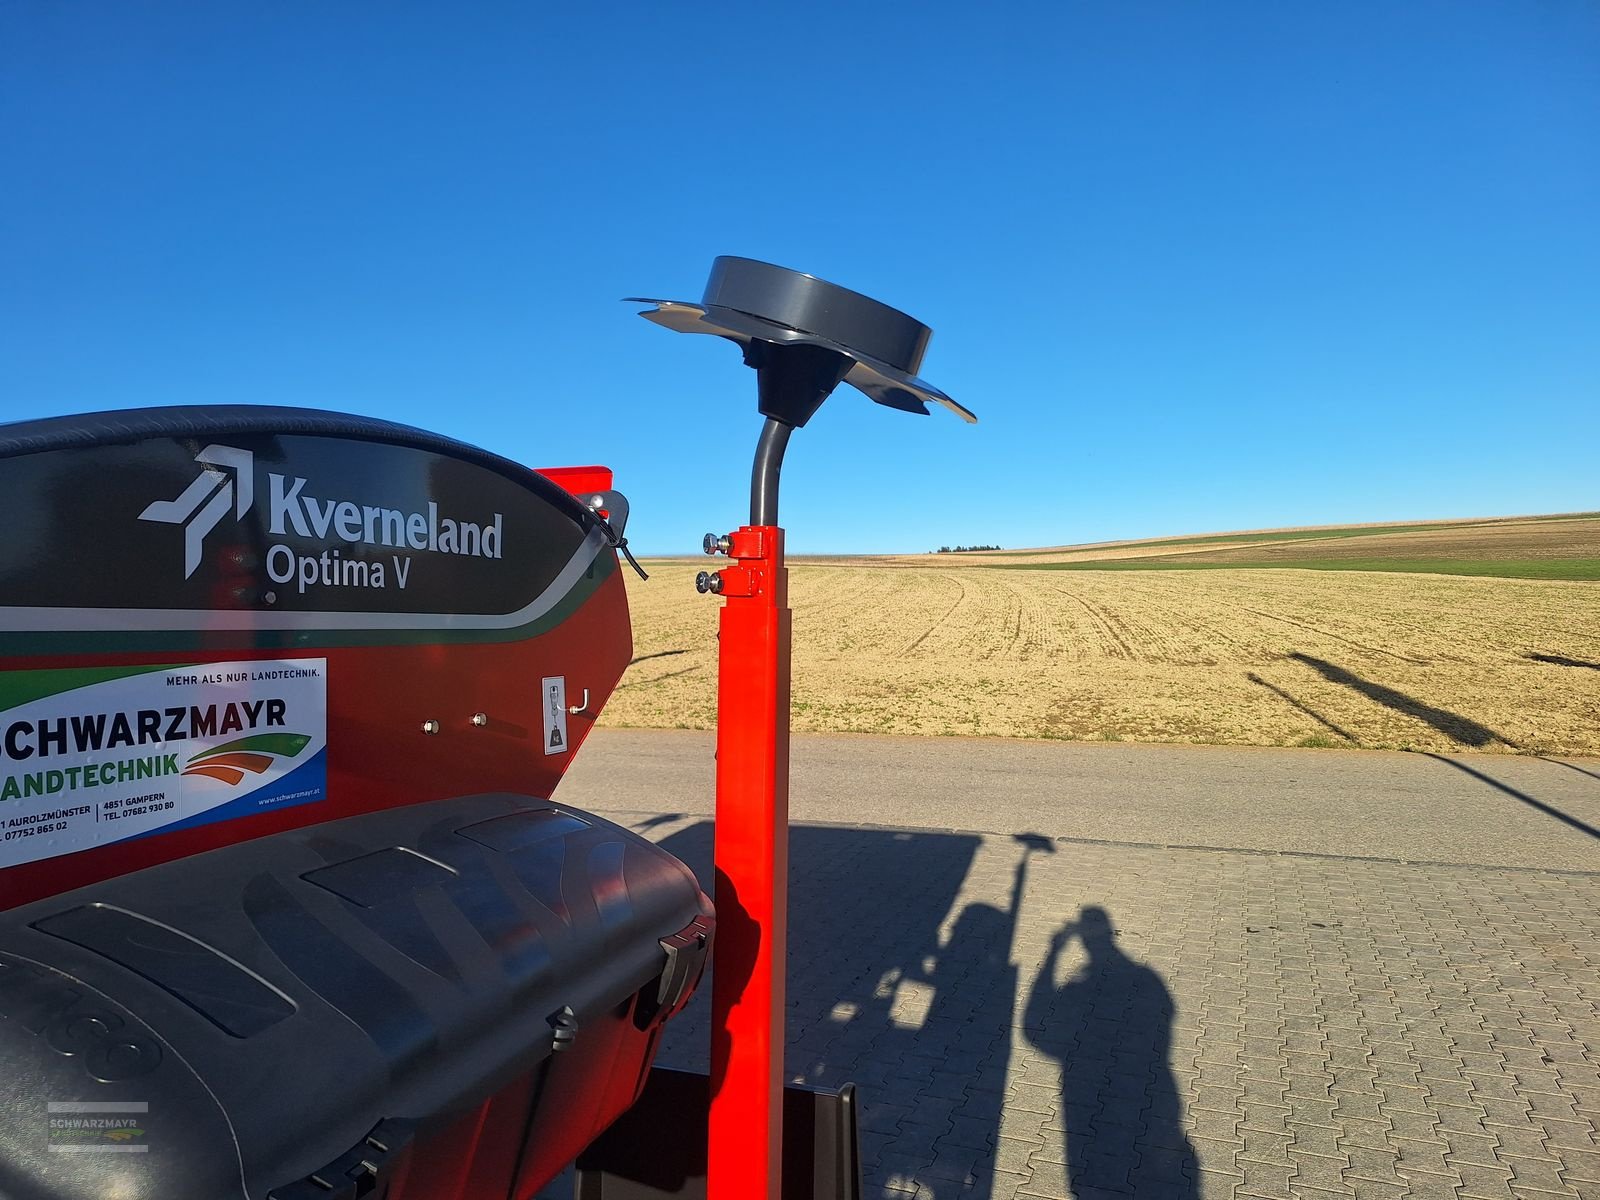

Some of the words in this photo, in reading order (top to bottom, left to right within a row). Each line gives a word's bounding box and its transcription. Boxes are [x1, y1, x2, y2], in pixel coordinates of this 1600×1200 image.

[267, 472, 503, 559] Kverneland
[265, 543, 386, 594] Optima
[392, 555, 411, 590] V
[166, 675, 198, 687] MEHR
[201, 674, 223, 684] ALS
[226, 672, 248, 683] NUR
[251, 668, 320, 681] LANDTECHNIK.
[0, 698, 287, 761] CHWARZMAYR
[103, 799, 123, 810] 4851
[125, 792, 165, 806] GAMPERN
[257, 787, 321, 806] www.schwarzmayr.at
[8, 805, 91, 829] AUROLZMÜNSTER
[122, 806, 147, 818] 07682
[148, 803, 163, 812] 930
[164, 801, 175, 810] 80
[5, 825, 35, 841] 07752
[36, 823, 54, 835] 865
[56, 821, 68, 831] 02
